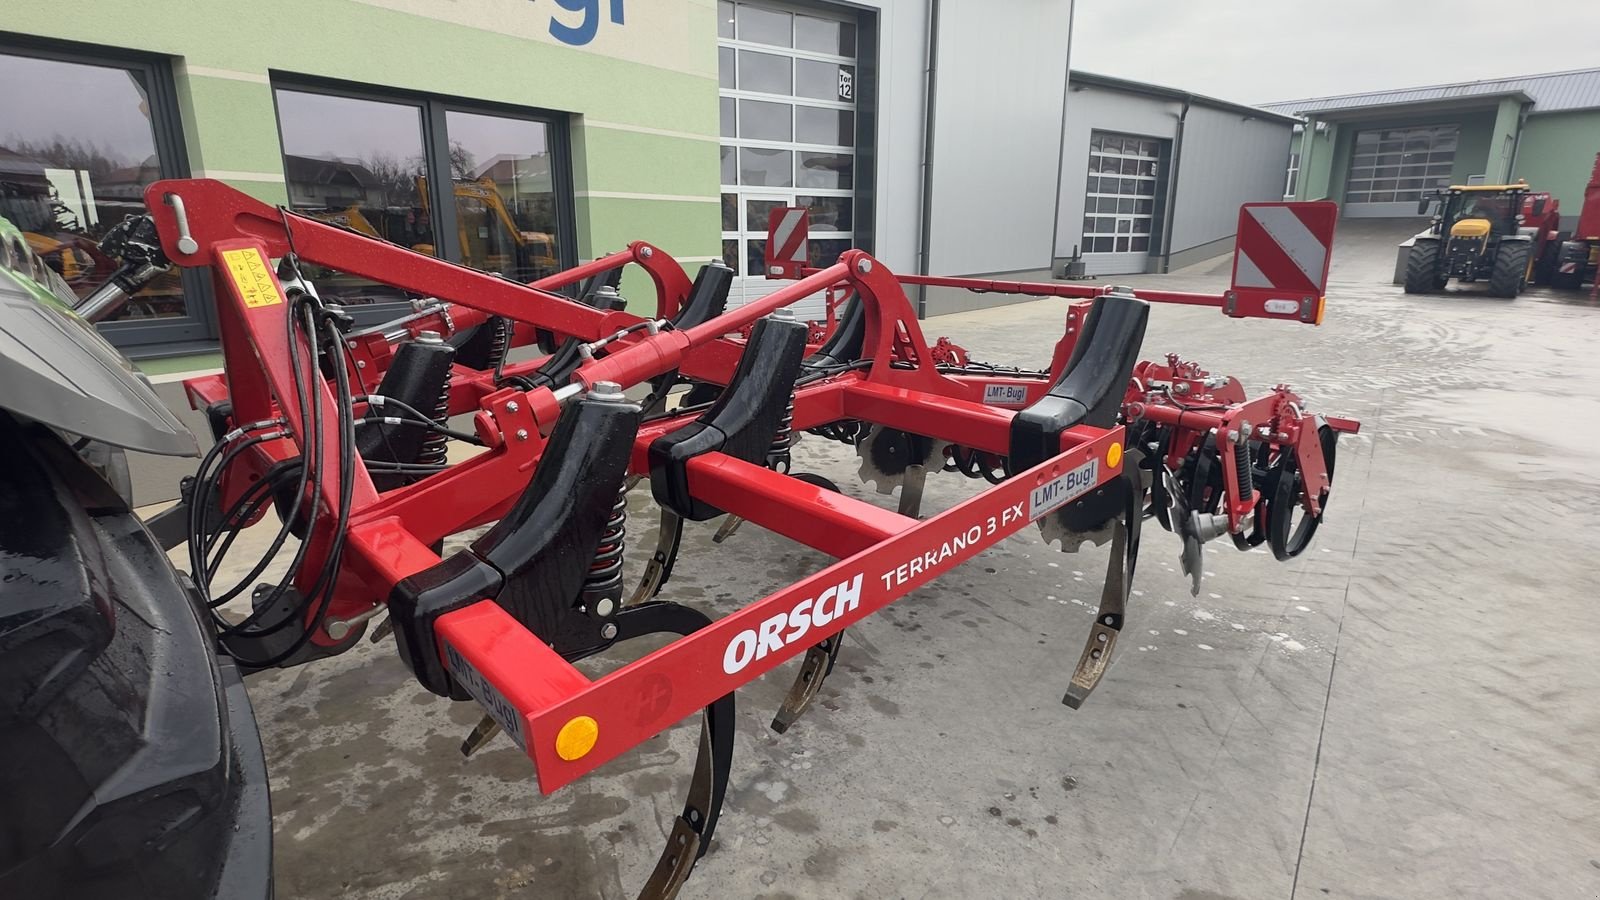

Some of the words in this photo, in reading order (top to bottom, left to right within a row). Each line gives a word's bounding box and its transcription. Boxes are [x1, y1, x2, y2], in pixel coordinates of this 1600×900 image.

[840, 84, 851, 96] 12
[723, 572, 864, 675] ORSCH
[881, 525, 981, 591] TERRANO
[987, 517, 996, 536] 3
[1002, 501, 1024, 527] FX
